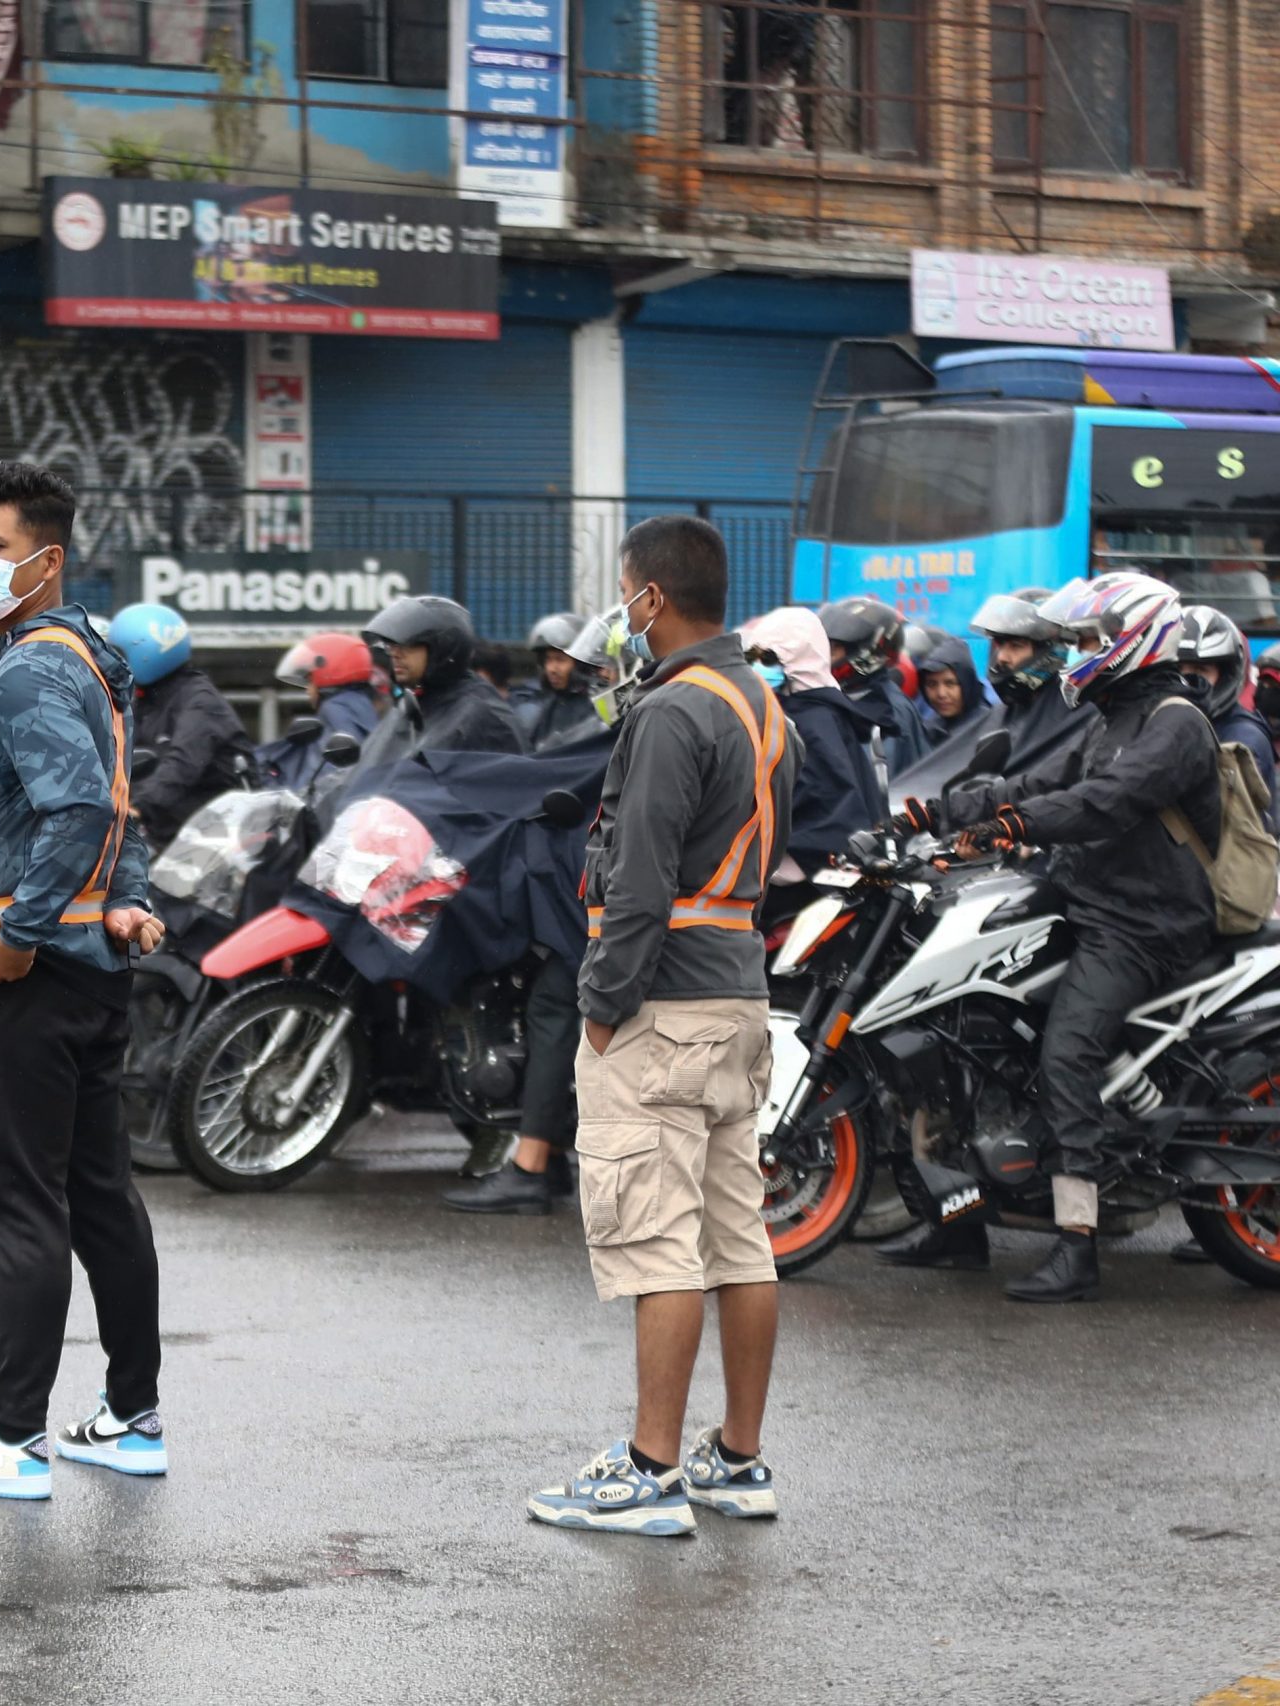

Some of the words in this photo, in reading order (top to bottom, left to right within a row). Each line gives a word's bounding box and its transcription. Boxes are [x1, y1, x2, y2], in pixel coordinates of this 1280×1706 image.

[118, 203, 191, 241] MEP
[199, 207, 304, 248] Smart
[310, 213, 454, 254] Services
[976, 257, 1032, 299] It's
[1038, 263, 1156, 308] Ocean
[974, 302, 1160, 337] Collection
[142, 558, 409, 611] Panasonic
